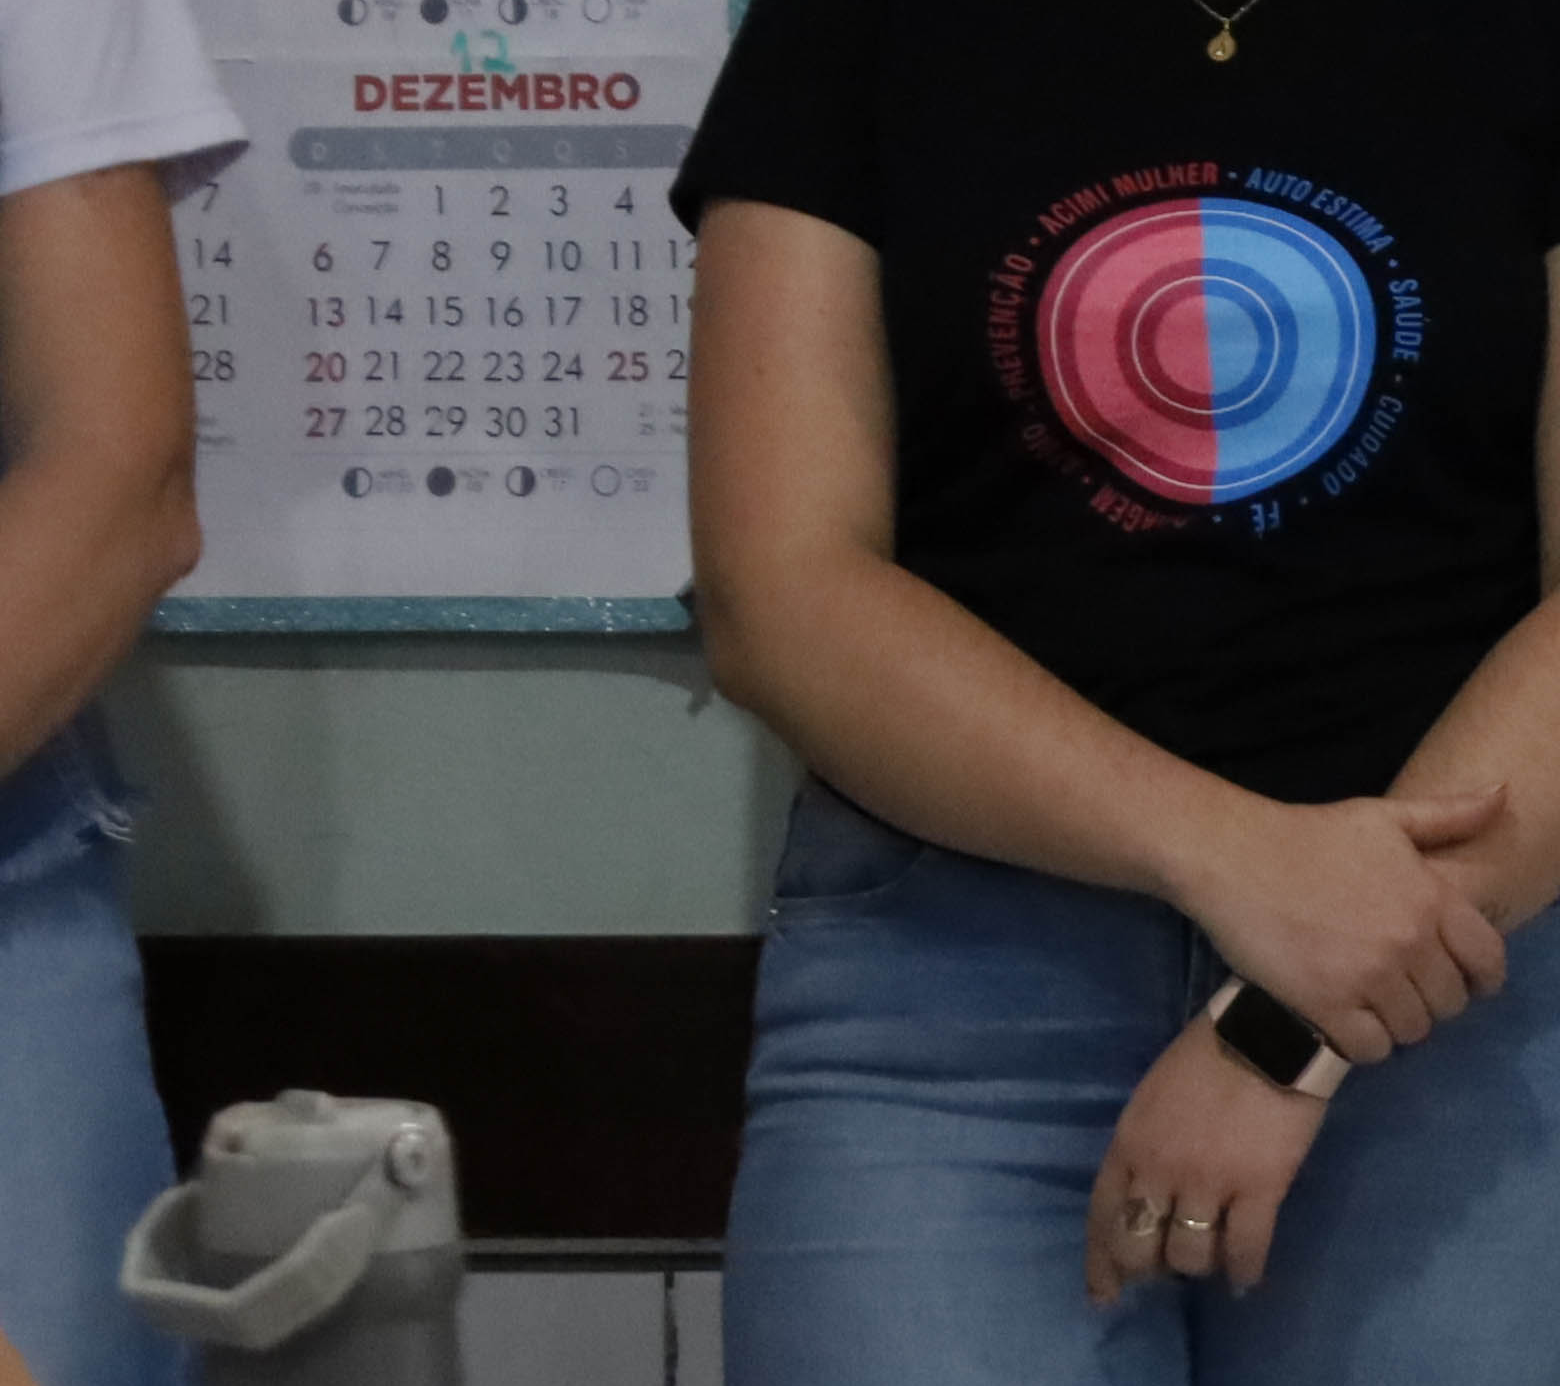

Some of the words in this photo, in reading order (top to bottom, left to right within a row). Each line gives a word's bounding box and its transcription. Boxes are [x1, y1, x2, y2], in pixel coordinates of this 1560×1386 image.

[451, 29, 516, 73] 12
[354, 73, 642, 112] DEZEMBRO
[201, 181, 220, 212] 7
[1111, 161, 1220, 198] MULHER
[1244, 166, 1315, 202] AUTO
[434, 184, 445, 215] 1
[489, 184, 511, 216] 2
[550, 184, 570, 217] 3
[614, 186, 635, 214] 4
[1036, 183, 1111, 236] ACIMI
[1309, 187, 1395, 255] ESTIMA
[194, 237, 233, 269] 14
[313, 242, 334, 272] 6
[370, 240, 391, 271] 7
[431, 240, 452, 272] 8
[490, 240, 512, 271] 9
[544, 240, 582, 272] 10
[608, 240, 642, 272] 11
[190, 293, 228, 326] 21
[306, 296, 346, 328] 13
[366, 295, 404, 327] 14
[426, 295, 465, 327] 15
[485, 295, 525, 328] 16
[545, 295, 583, 327] 17
[611, 294, 650, 328] 18
[1387, 277, 1433, 363] SAÚDE
[191, 349, 236, 382] 28
[304, 351, 347, 383] 20
[363, 350, 401, 382] 21
[423, 350, 466, 382] 22
[483, 350, 526, 382] 23
[541, 350, 584, 382] 24
[606, 350, 650, 383] 25
[305, 407, 347, 438] 27
[365, 405, 407, 438] 28
[424, 406, 467, 439] 29
[484, 406, 527, 438] 30
[544, 406, 580, 438] 31
[1321, 393, 1404, 497] CUIDADO
